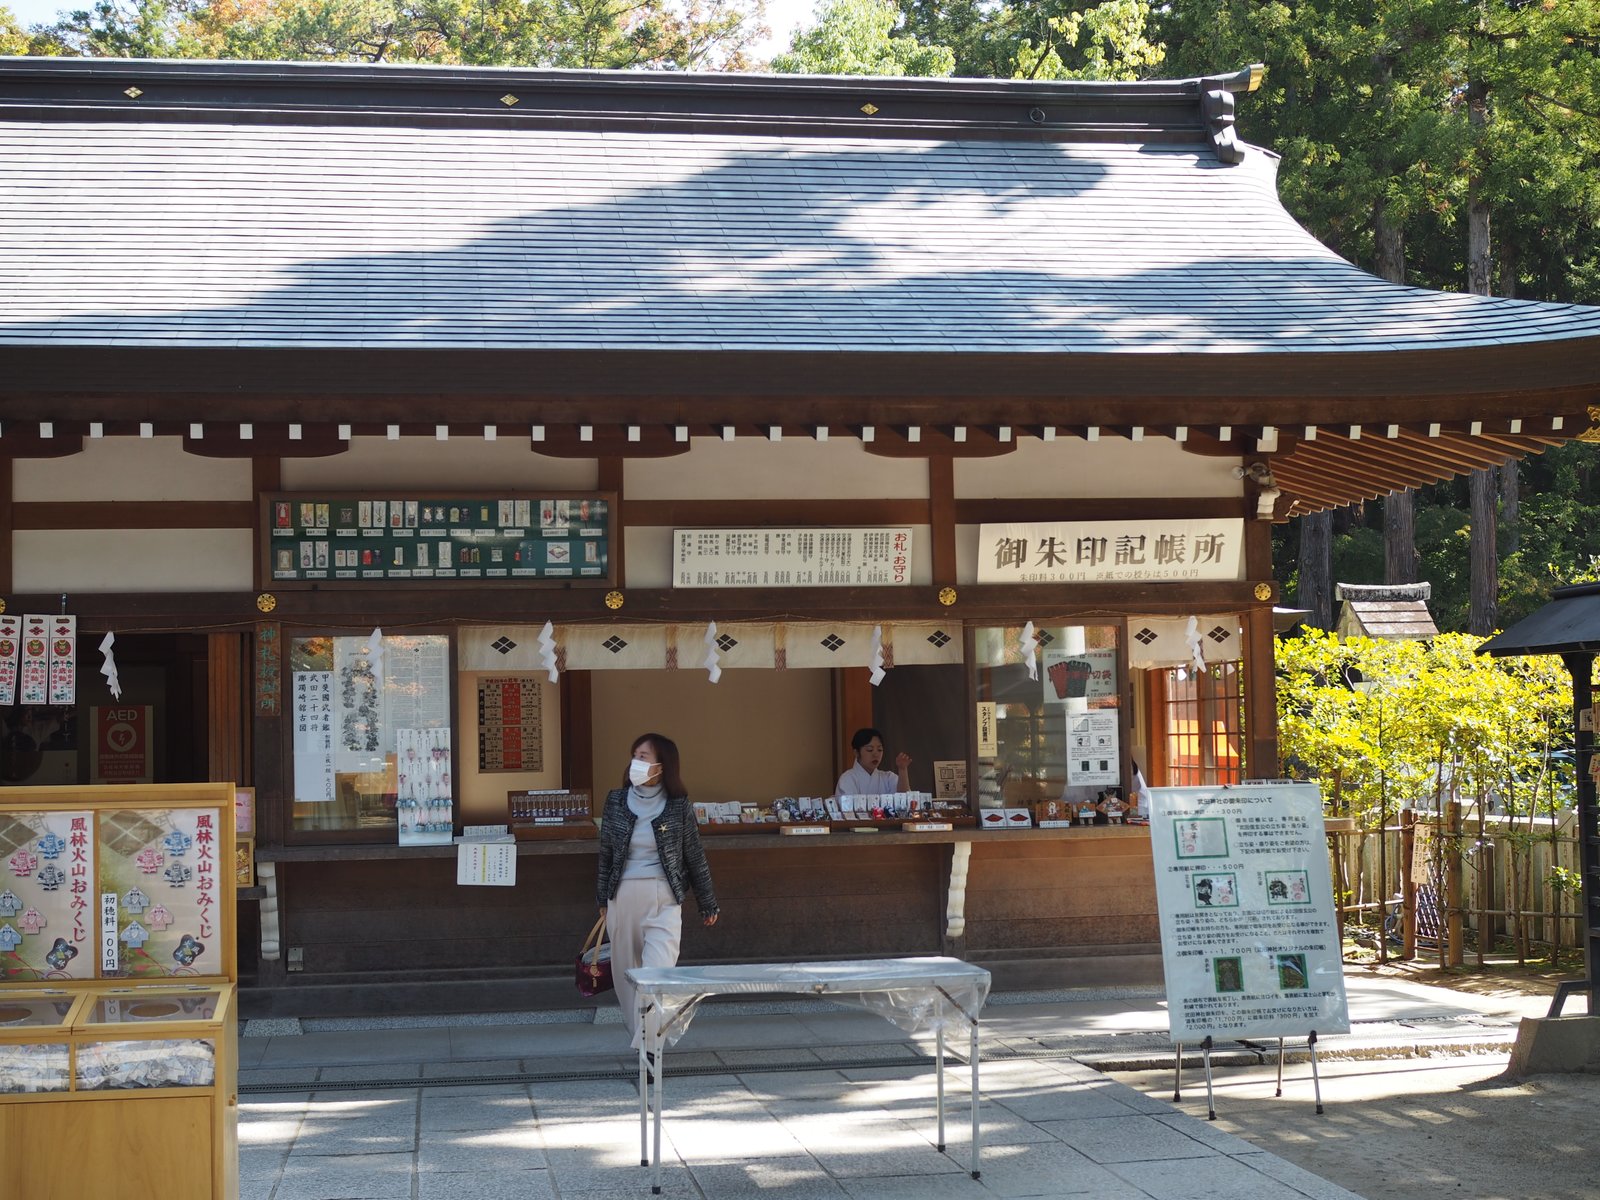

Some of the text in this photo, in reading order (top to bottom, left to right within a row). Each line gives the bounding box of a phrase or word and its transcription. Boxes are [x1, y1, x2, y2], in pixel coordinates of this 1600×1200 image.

[893, 533, 908, 583] お札・お守り
[994, 532, 1225, 569] 御朱印記帳所
[106, 710, 138, 720] AED
[70, 817, 88, 942] 風林火山おみくじ
[196, 814, 214, 939] 風林火山おみくじ
